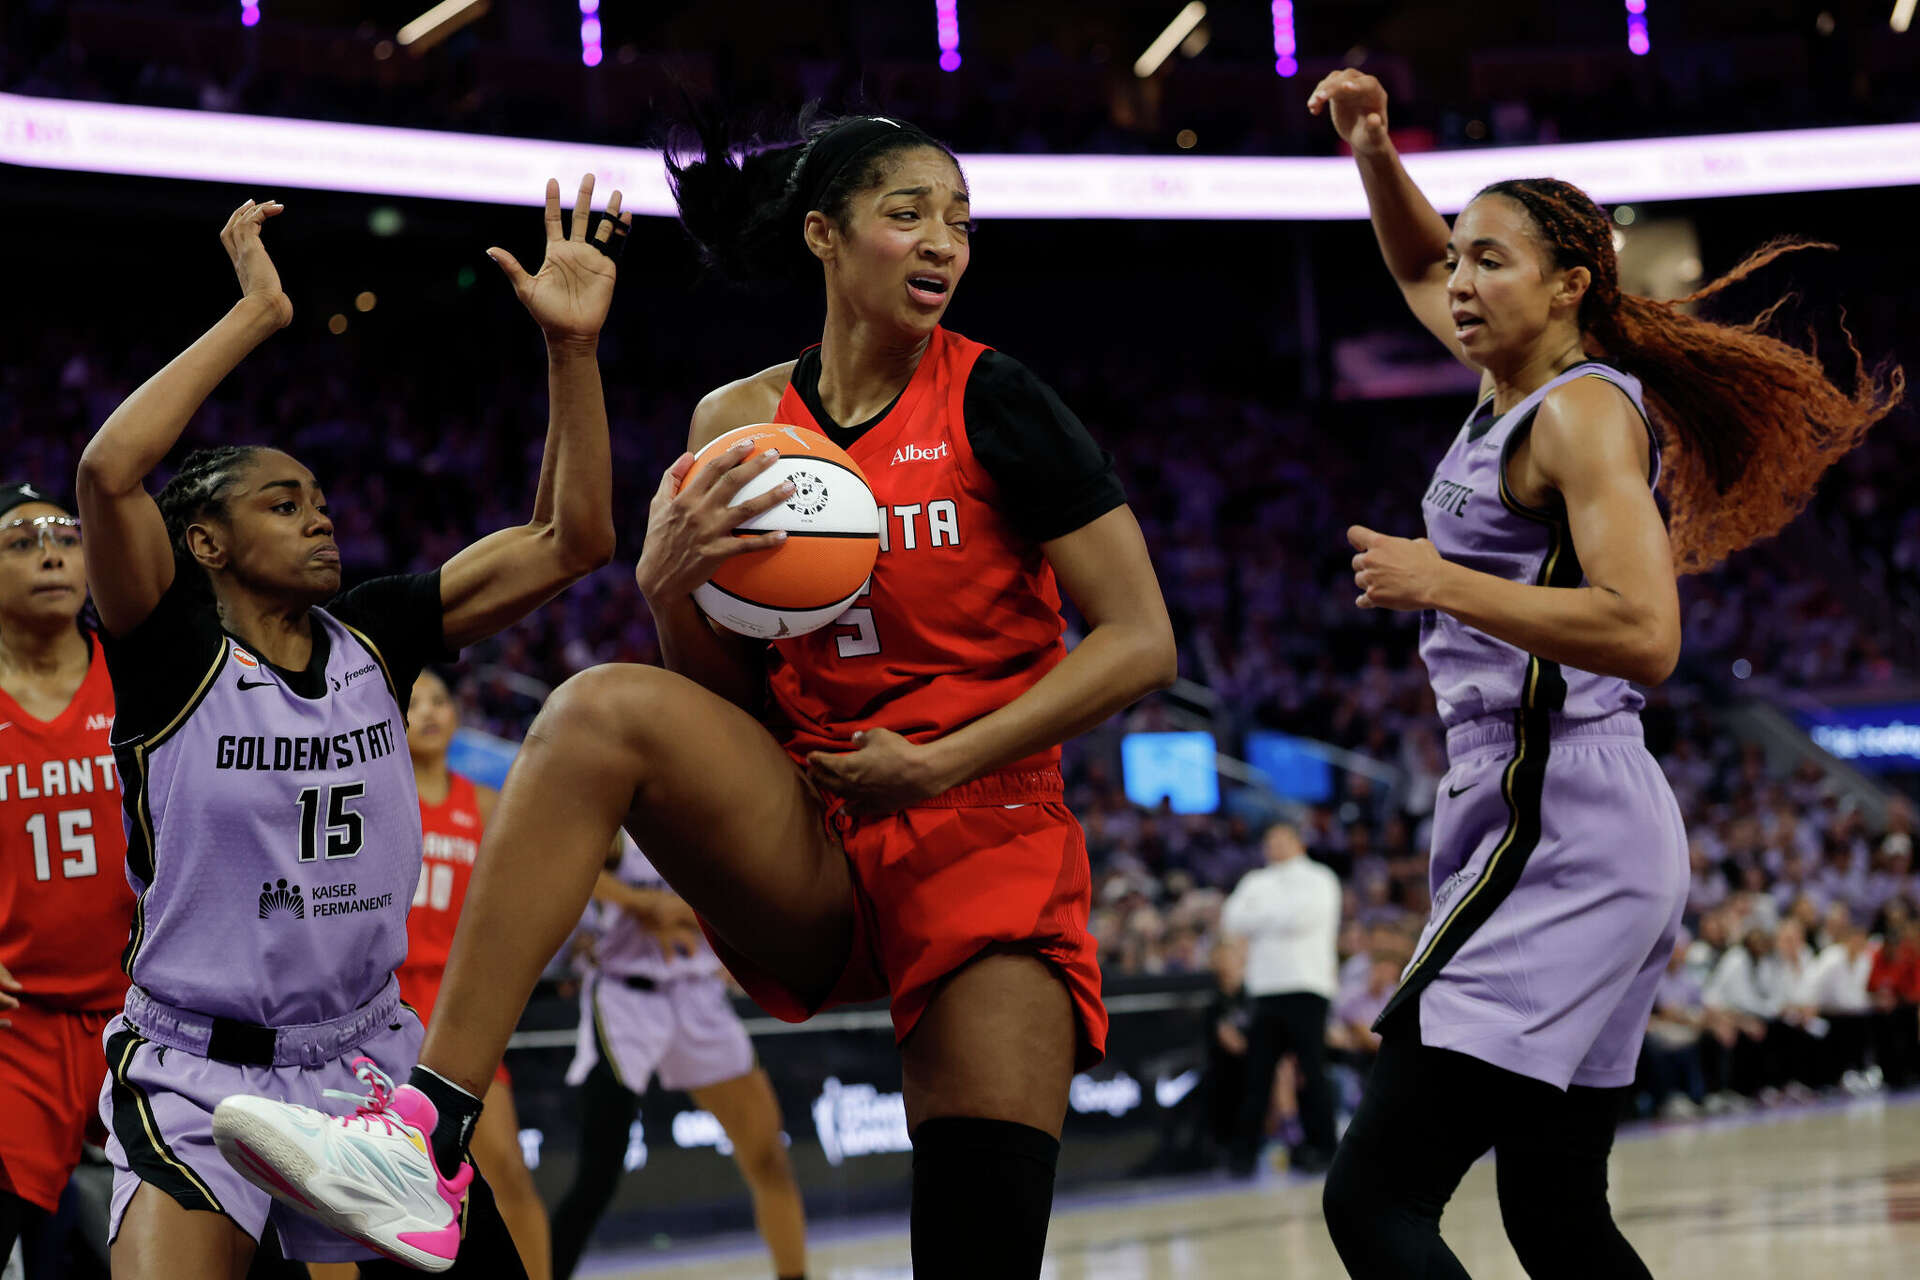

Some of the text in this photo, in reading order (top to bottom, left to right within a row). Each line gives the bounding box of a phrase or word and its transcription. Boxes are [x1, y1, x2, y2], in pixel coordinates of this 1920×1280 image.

[890, 441, 948, 466] Albert
[1427, 480, 1474, 518] STATE
[332, 718, 395, 769] STAT
[295, 780, 365, 863] 15
[26, 808, 98, 881] 15
[312, 883, 357, 900] KAISER
[313, 892, 393, 917] PERMANENTE
